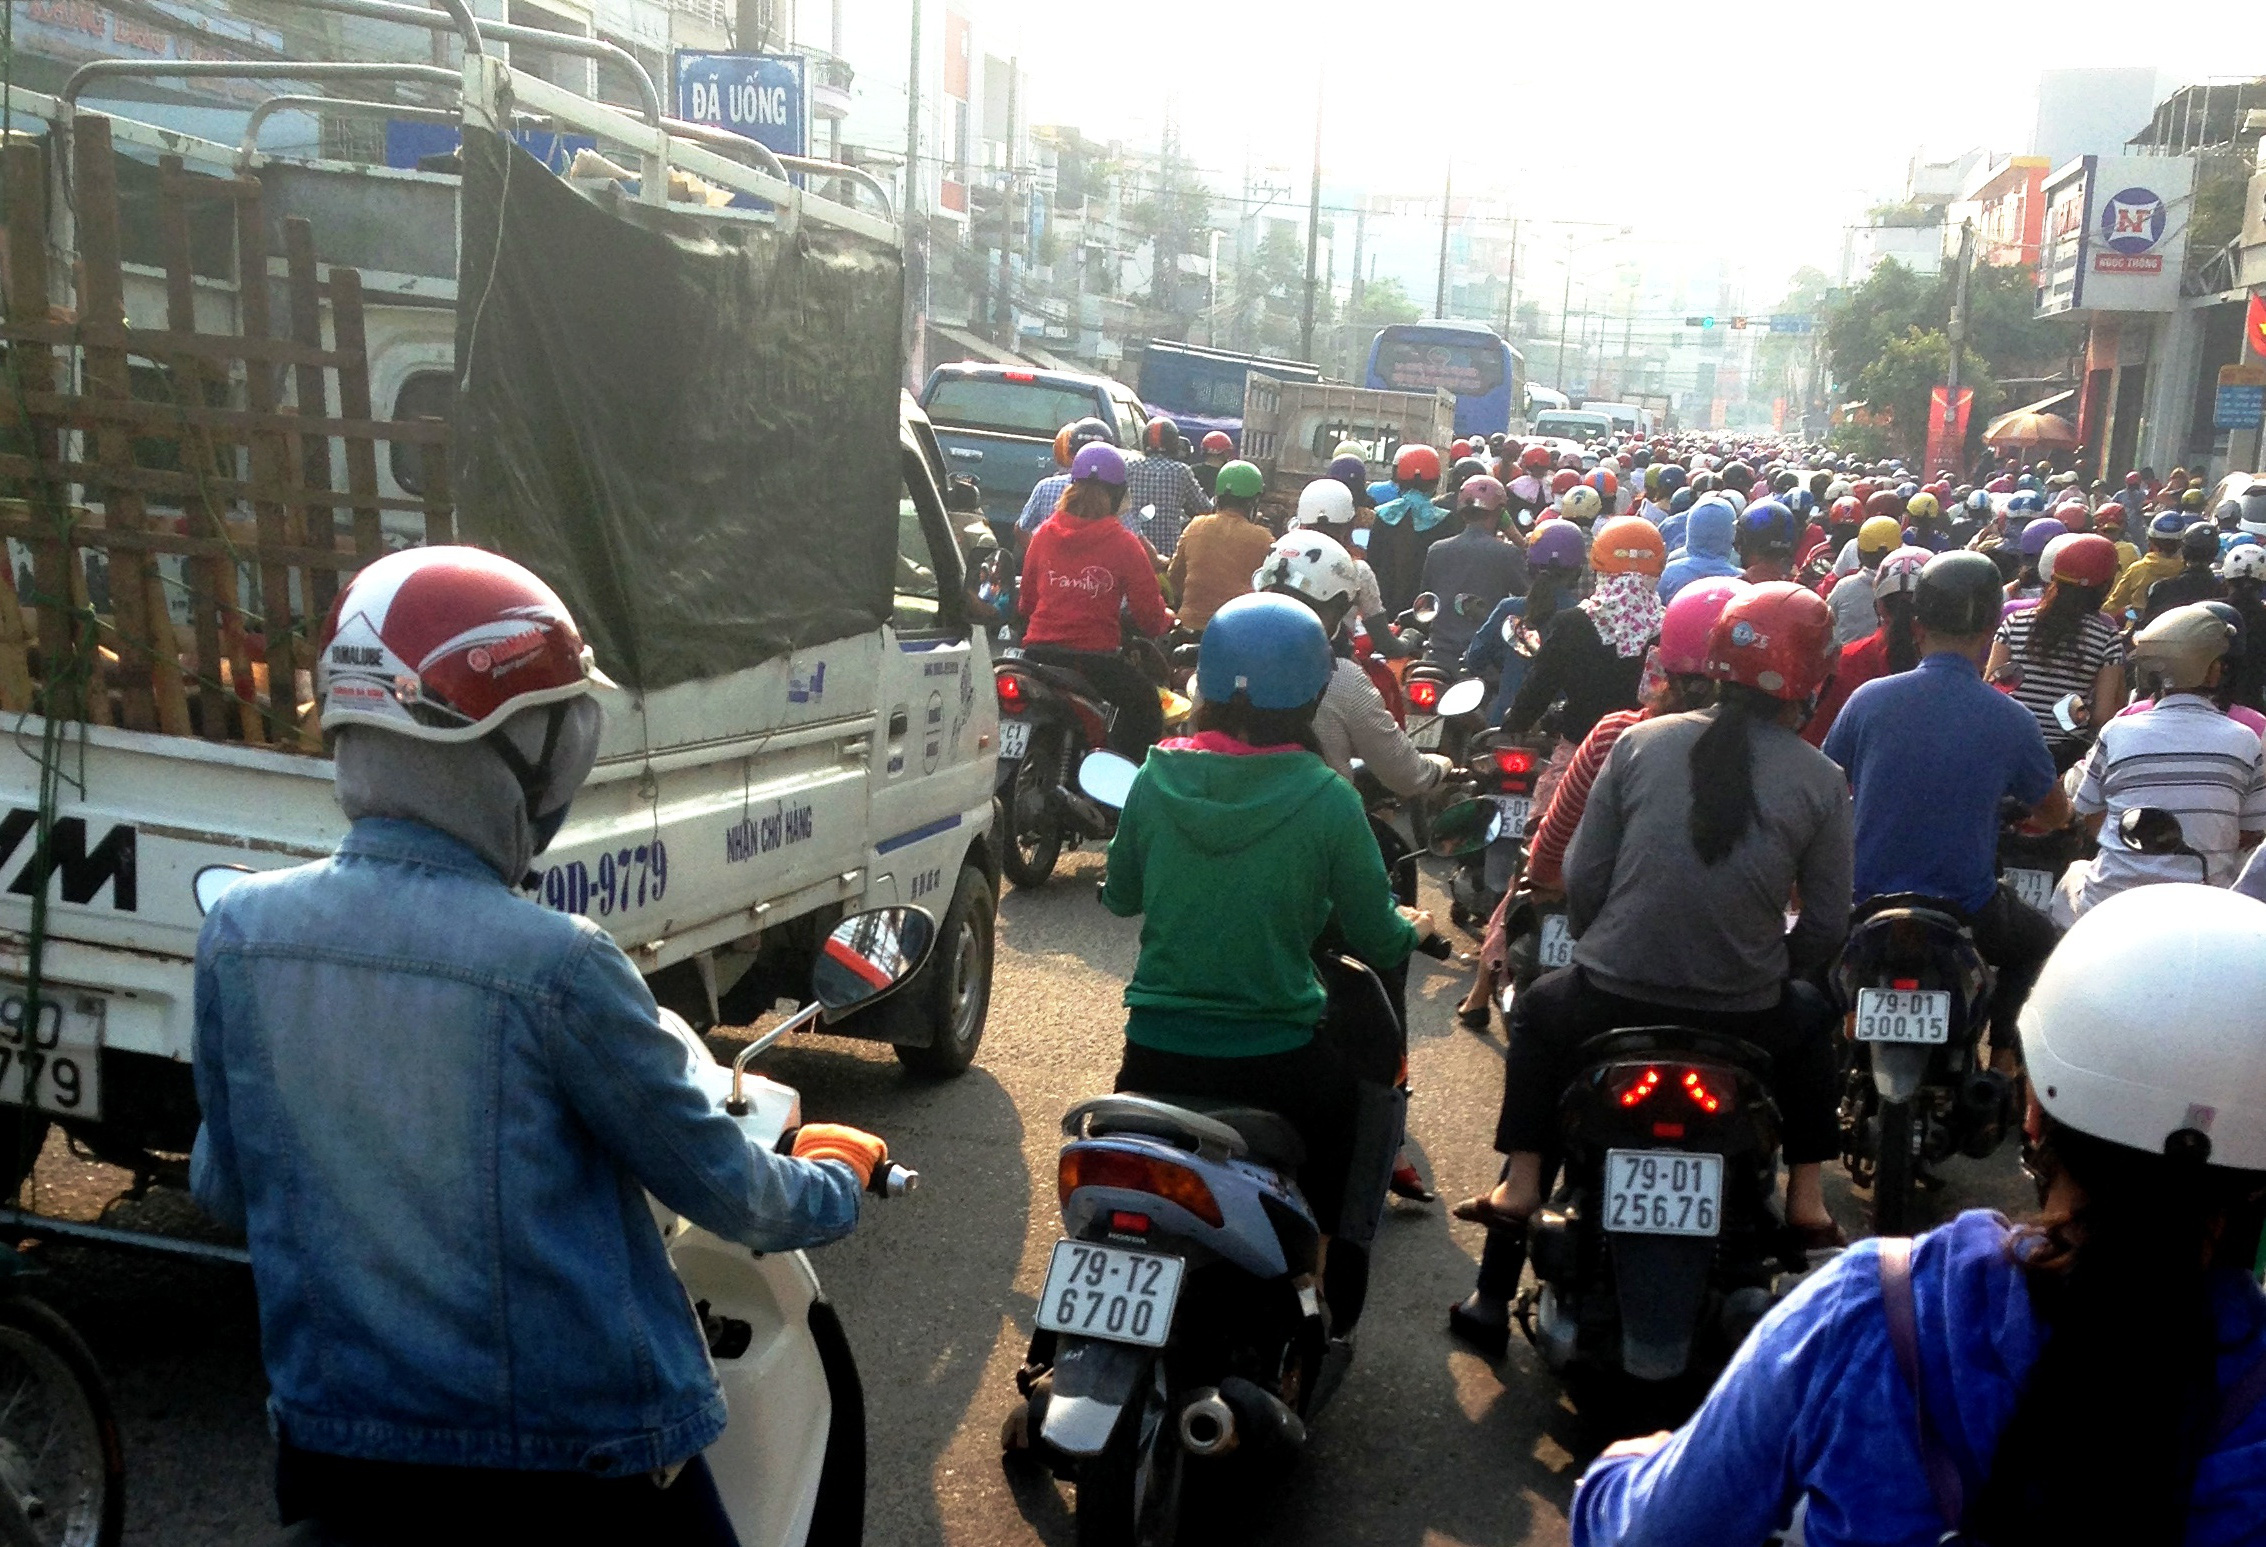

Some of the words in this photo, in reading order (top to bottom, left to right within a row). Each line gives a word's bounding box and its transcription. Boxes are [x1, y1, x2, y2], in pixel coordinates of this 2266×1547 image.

[692, 73, 721, 120] ĐÃ
[729, 70, 787, 126] UỐNG
[1047, 569, 1100, 599] Family
[1862, 1016, 1943, 1039] 300.15
[1611, 1193, 1713, 1229] 256.76
[1067, 1247, 1164, 1297] 79-T2
[1056, 1288, 1154, 1336] 6700
